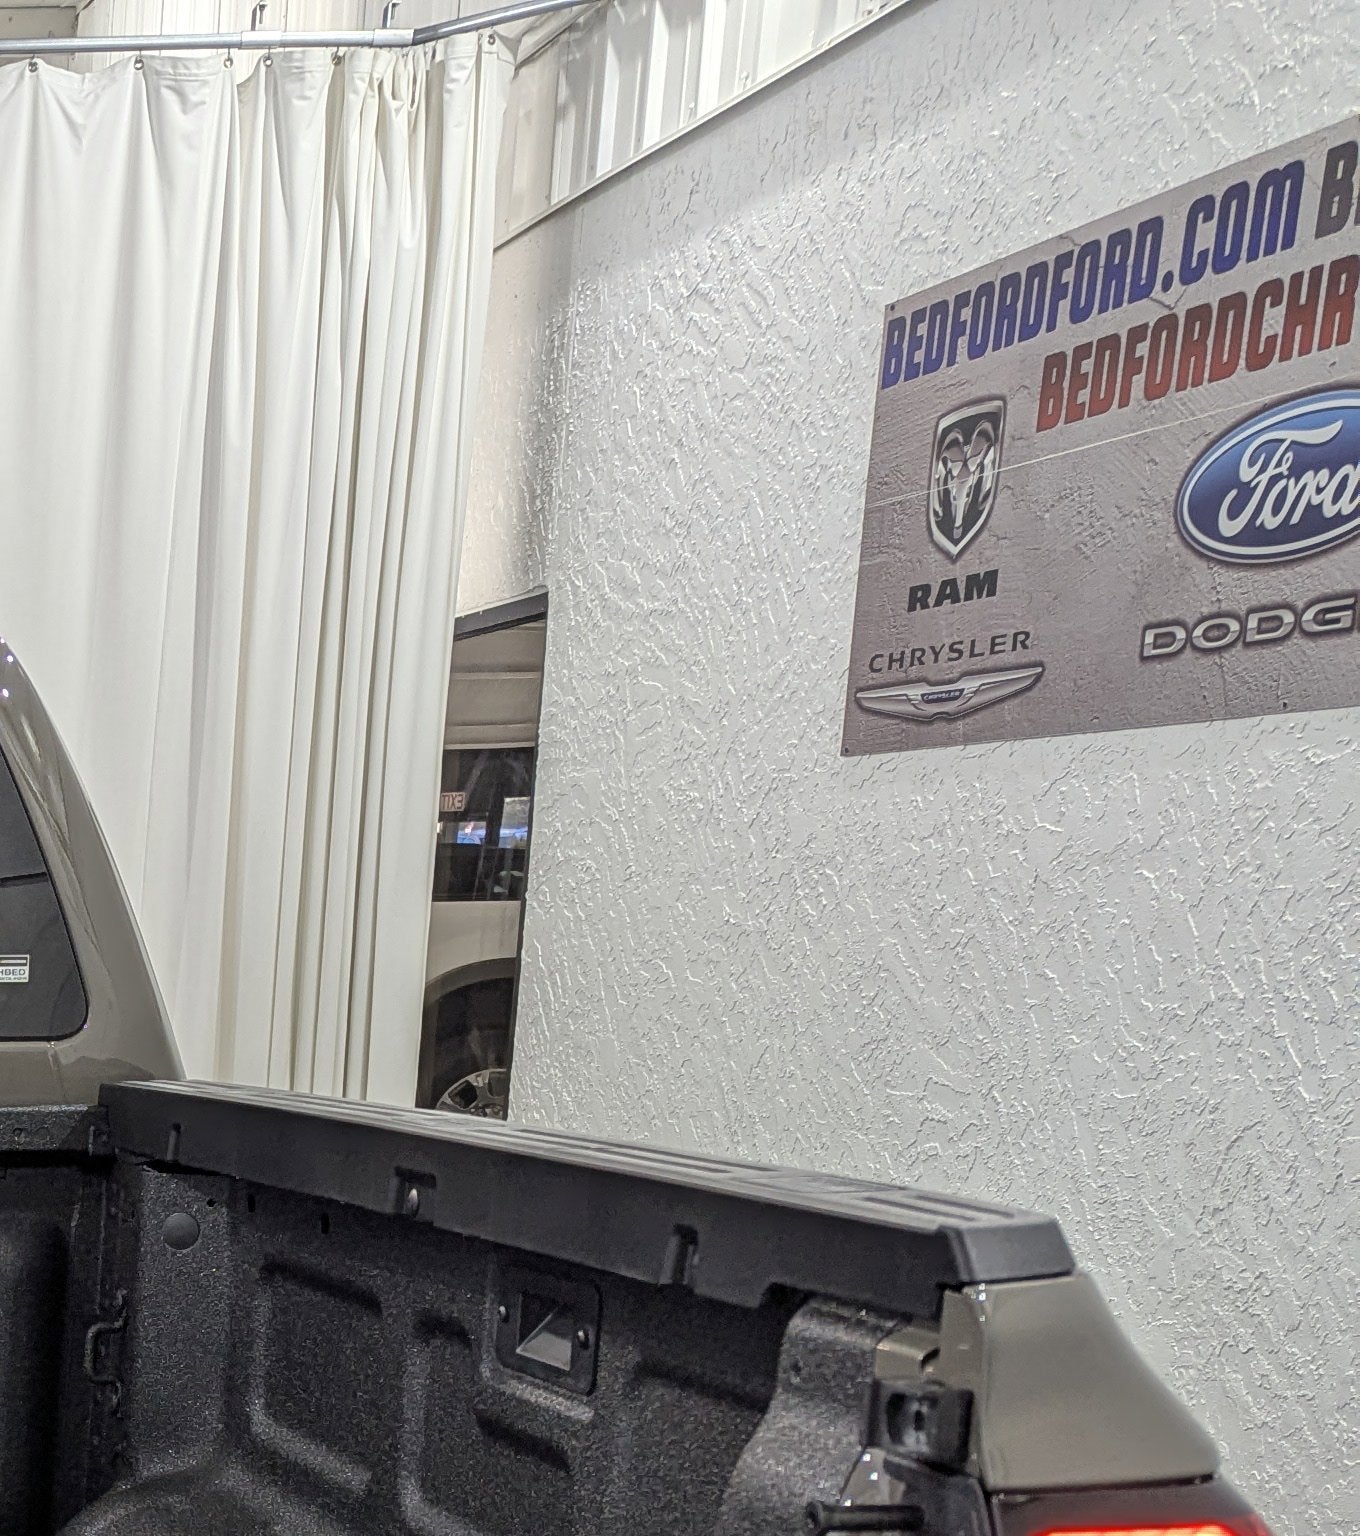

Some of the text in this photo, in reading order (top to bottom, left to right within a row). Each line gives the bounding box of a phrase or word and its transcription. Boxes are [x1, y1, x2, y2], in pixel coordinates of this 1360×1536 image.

[881, 140, 1360, 390] BEDFORDFORD.COM B
[1036, 254, 1360, 432] BEDFORDCHR
[907, 569, 999, 612] RAM
[868, 631, 1030, 673] CHRYSLER
